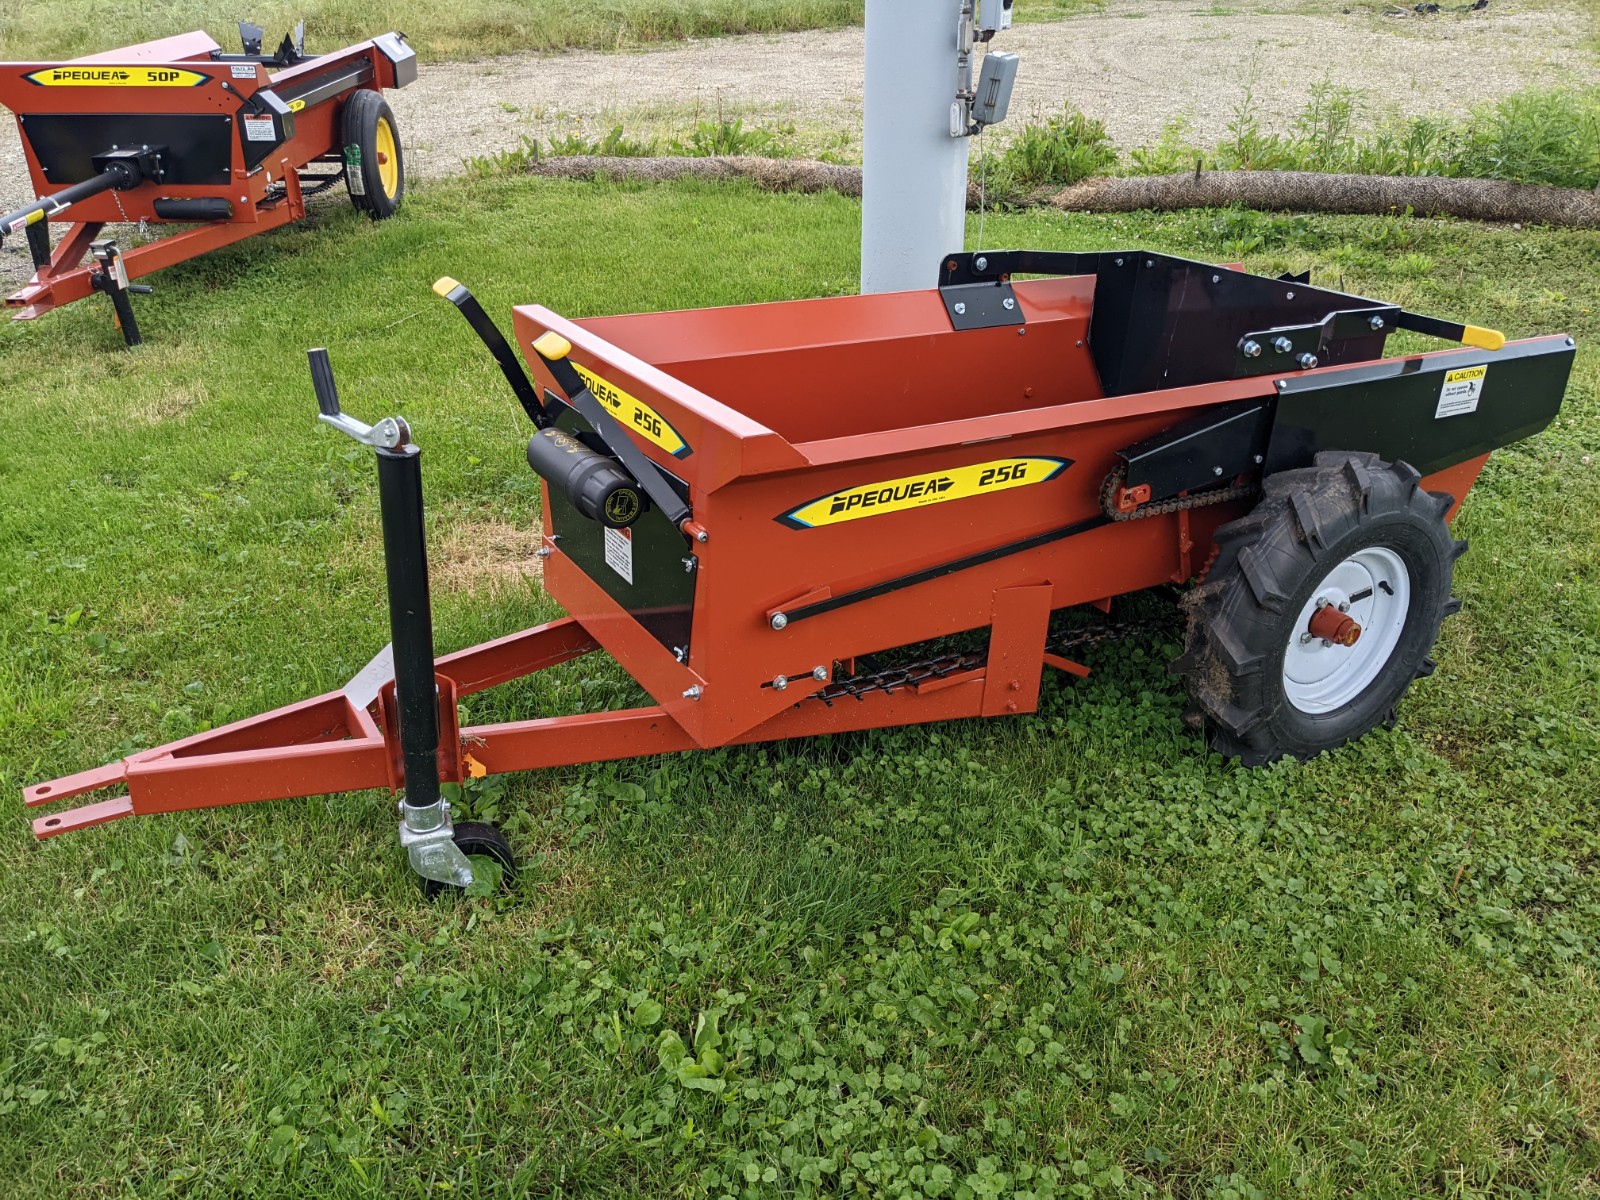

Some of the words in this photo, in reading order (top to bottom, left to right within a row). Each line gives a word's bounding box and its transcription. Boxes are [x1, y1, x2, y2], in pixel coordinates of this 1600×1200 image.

[62, 71, 120, 80] PEQUEA
[147, 71, 180, 82] 50P
[1454, 368, 1485, 381] CAUTION
[633, 406, 662, 438] 25G
[845, 478, 937, 511] PEQUEA
[978, 462, 1028, 487] 25G
